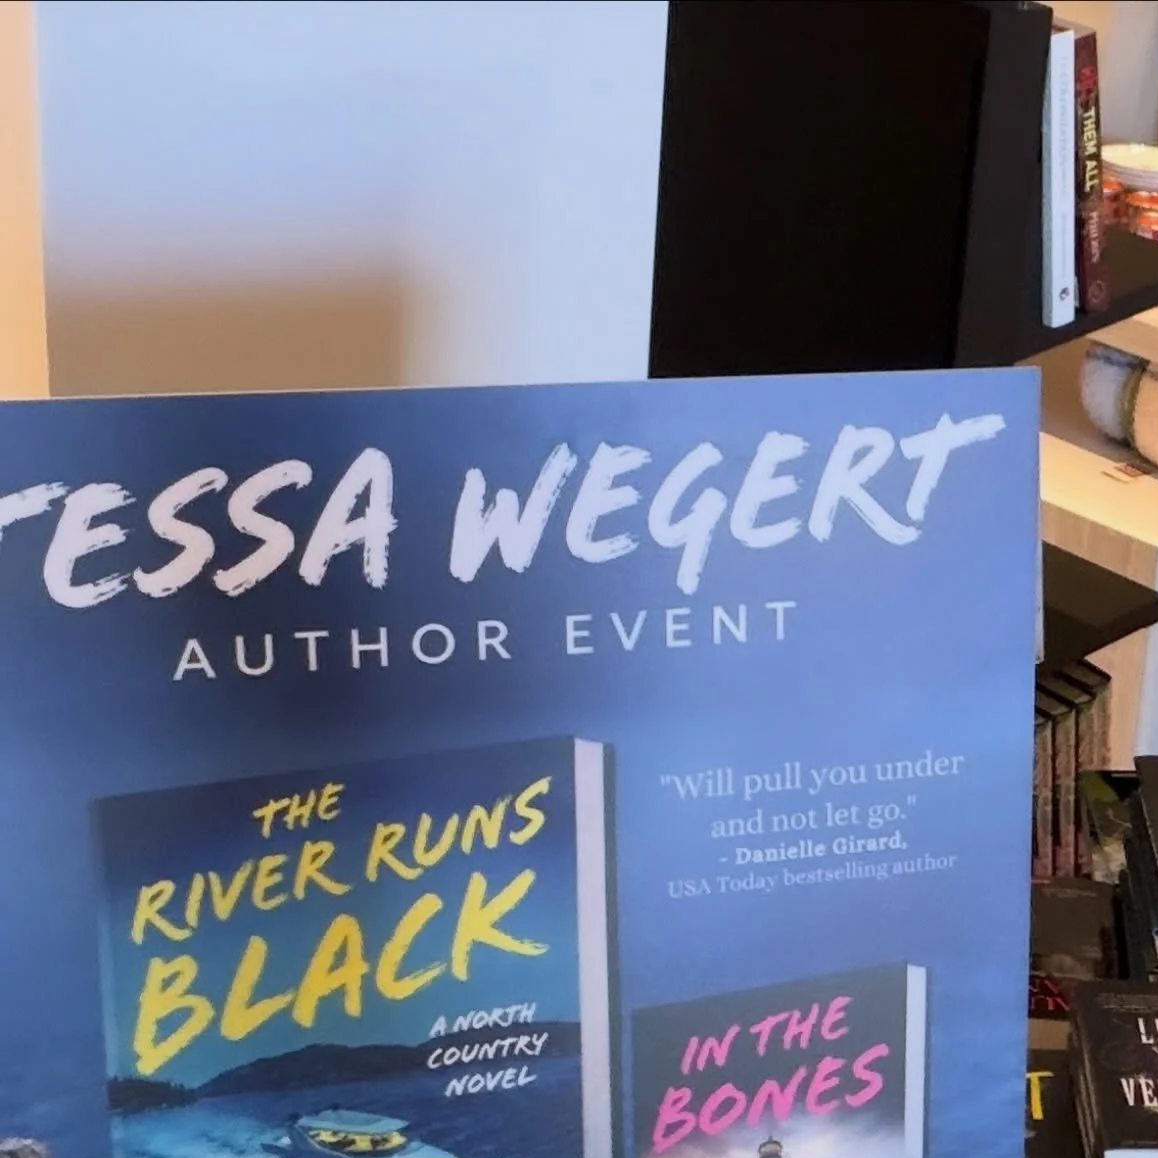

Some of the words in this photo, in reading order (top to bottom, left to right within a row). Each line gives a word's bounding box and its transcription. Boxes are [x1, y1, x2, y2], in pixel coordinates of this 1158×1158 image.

[1082, 105, 1098, 156] THEM
[1084, 160, 1100, 193] ALL
[450, 413, 1006, 595] WEGERT
[172, 619, 512, 681] AUTHOR
[565, 601, 797, 655] EVENT
[743, 762, 802, 801] pull
[808, 764, 867, 795] you
[876, 750, 966, 782] under
[252, 782, 346, 838] THE
[710, 809, 764, 838] and
[771, 811, 818, 833] not
[825, 802, 861, 828] let
[131, 840, 352, 944] RIVER
[366, 776, 553, 882] RUNS
[735, 839, 827, 865] Danielle
[832, 830, 908, 855] Girard,
[668, 879, 713, 898] USA
[716, 872, 778, 893] Today
[783, 862, 889, 887] bestselling
[892, 853, 958, 875] author
[132, 869, 551, 1076] BLACK
[429, 1015, 448, 1038] A
[452, 1002, 537, 1033] NORTH
[681, 1024, 741, 1076] IN
[749, 995, 855, 1057] THE
[427, 1032, 548, 1069] COUNTRY
[445, 1070, 537, 1097] NOVEL
[653, 1043, 890, 1155] BONES
